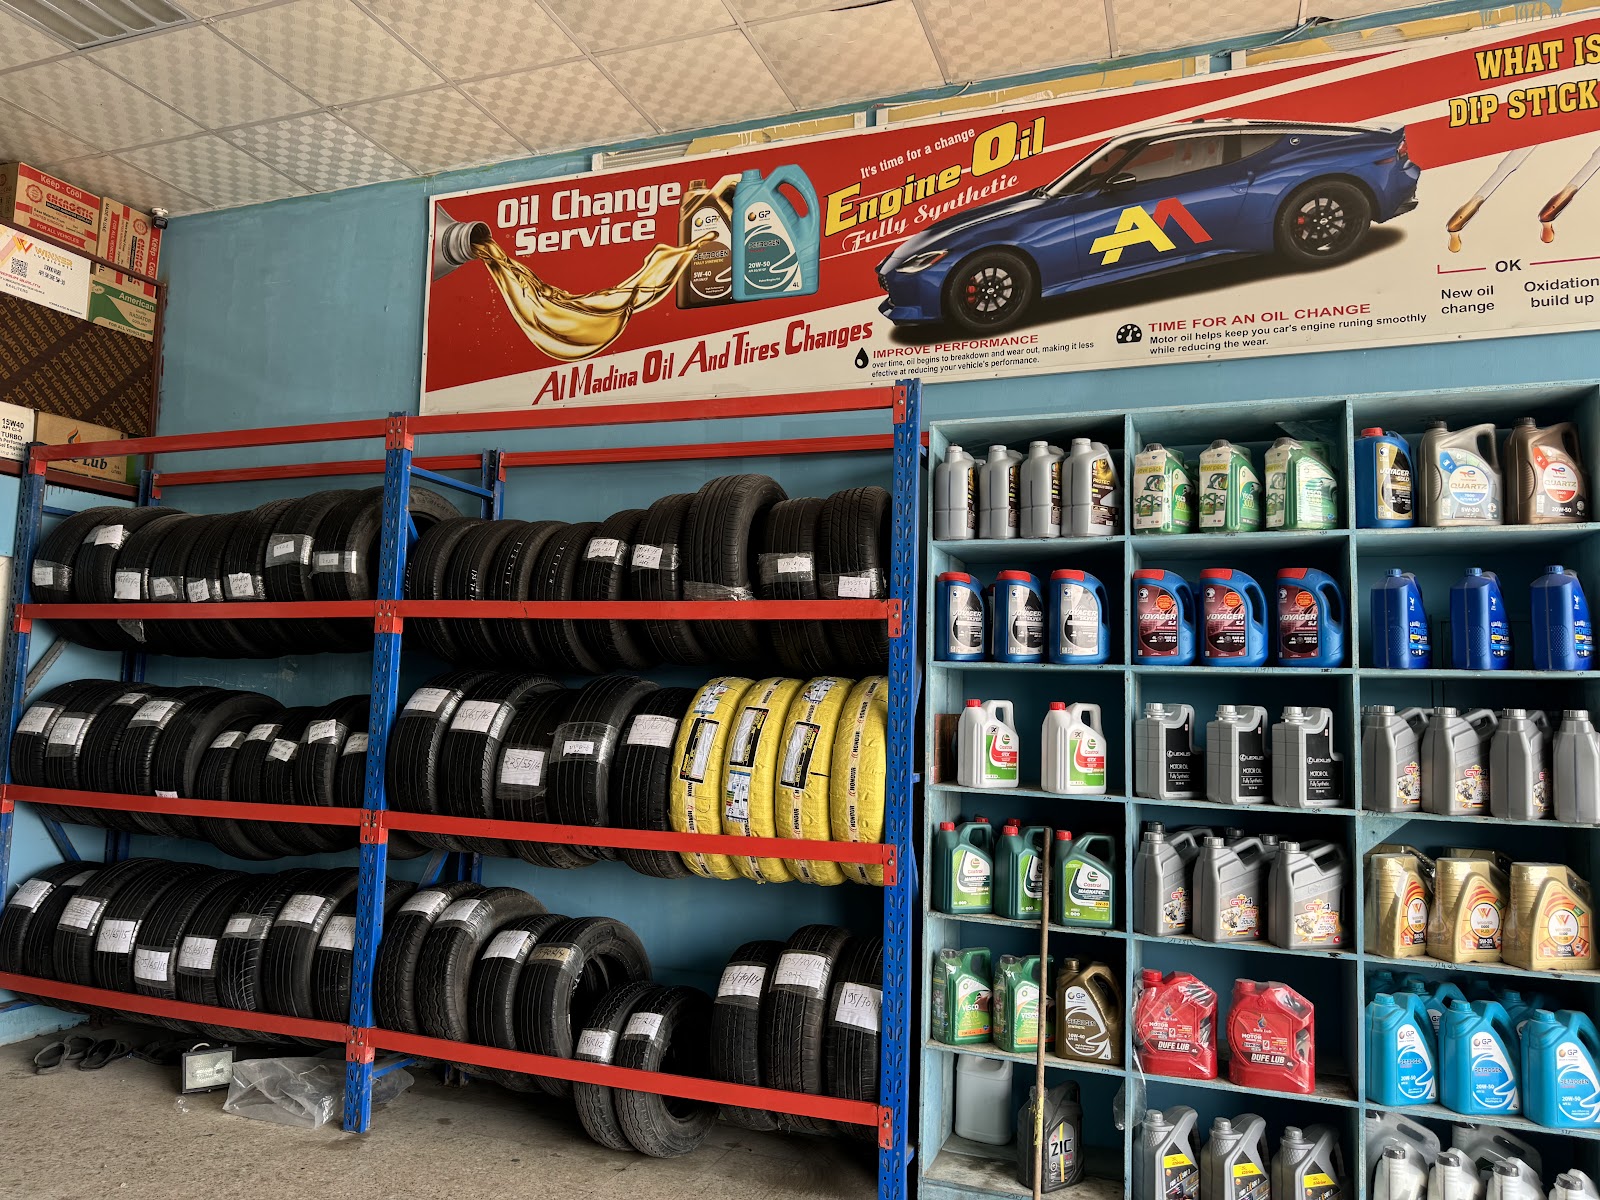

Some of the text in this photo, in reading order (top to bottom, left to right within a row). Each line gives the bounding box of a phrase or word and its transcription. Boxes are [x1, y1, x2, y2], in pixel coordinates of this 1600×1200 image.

[1475, 33, 1600, 81] WHAT IS
[1449, 79, 1600, 129] DIP STICK
[860, 128, 976, 180] It's time for a change
[824, 115, 1046, 238] Engine Oil
[40, 175, 61, 190] Keep
[66, 186, 82, 200] Cool
[497, 181, 682, 230] Oil Change
[842, 174, 1020, 252] Fully Synthetic
[758, 210, 771, 219] GP
[514, 217, 657, 257] Service
[748, 261, 771, 269] 20W-50
[1494, 258, 1523, 273] OK
[693, 271, 712, 279] 5W-40
[1441, 285, 1495, 300] New oil
[1523, 276, 1600, 293] Oxidation
[119, 292, 155, 312] American
[1441, 302, 1495, 316] change
[1530, 293, 1595, 309] build up
[1148, 303, 1371, 333] TIME FOR AN OIL CHANGE
[1150, 312, 1427, 344] Motor oil helps keep you car's engine runing smoothly
[873, 334, 1039, 358] IMPROVE PERFORMANCE
[1150, 338, 1269, 354] while reducing the wear.
[531, 319, 874, 405] Al Madina Oil And Tires Changes
[872, 360, 887, 369] over
[888, 359, 905, 368] time,
[906, 357, 915, 365] oil
[917, 355, 940, 366] begins
[941, 354, 949, 362] to
[950, 351, 990, 361] breakdown
[991, 349, 1005, 357] and
[1006, 348, 1024, 356] wear
[1026, 346, 1040, 355] out,
[1042, 343, 1070, 353] making
[1078, 341, 1094, 349] less
[871, 368, 898, 378] efective
[908, 364, 938, 374] reducing
[939, 362, 956, 372] your
[958, 359, 989, 370] vehicle's
[991, 357, 1040, 368] performance.
[2, 418, 25, 429] 15W40
[1, 431, 23, 441] TURBO
[1450, 482, 1488, 490] QUARTZ
[1544, 479, 1577, 488] QUARTZ
[1139, 613, 1177, 621] VOYAGER
[1206, 613, 1244, 621] VOYAGER
[1280, 613, 1317, 621] VOYAGER
[1157, 1040, 1190, 1051] DUFE LUB
[1251, 1053, 1285, 1064] DUFE LUB
[1051, 1138, 1073, 1157] ZIC
